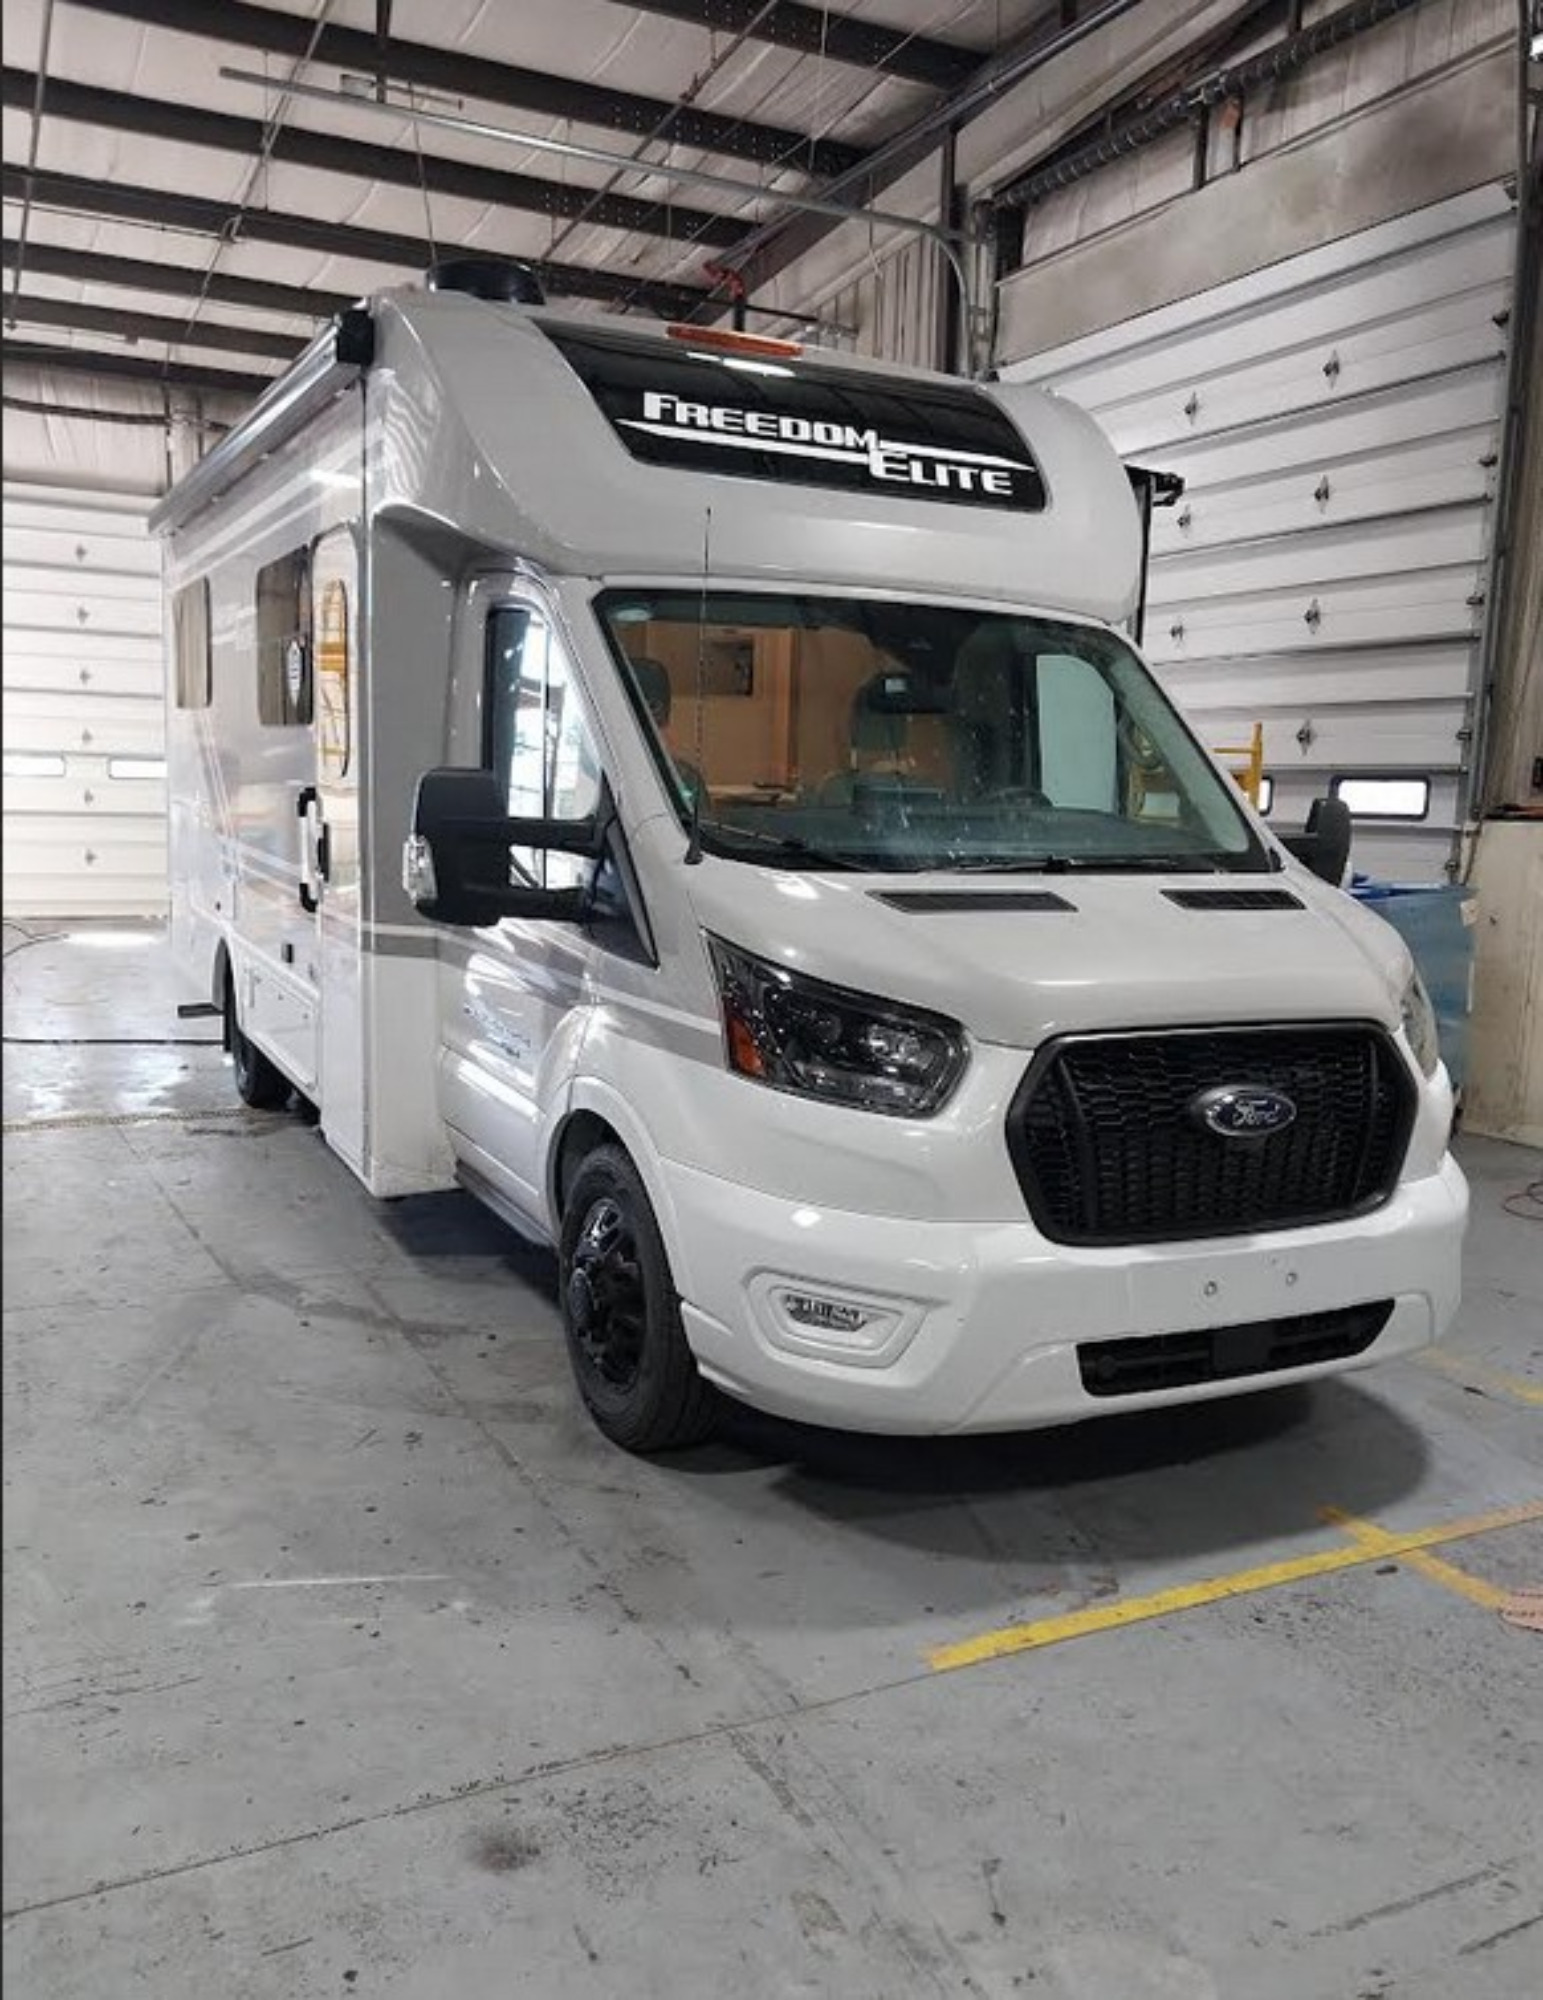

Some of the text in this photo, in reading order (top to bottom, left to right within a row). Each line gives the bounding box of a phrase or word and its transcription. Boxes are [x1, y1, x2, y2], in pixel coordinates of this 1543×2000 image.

[643, 391, 879, 448] FREEDOM
[868, 450, 1013, 495] ELITE
[1231, 1099, 1279, 1125] Ford
